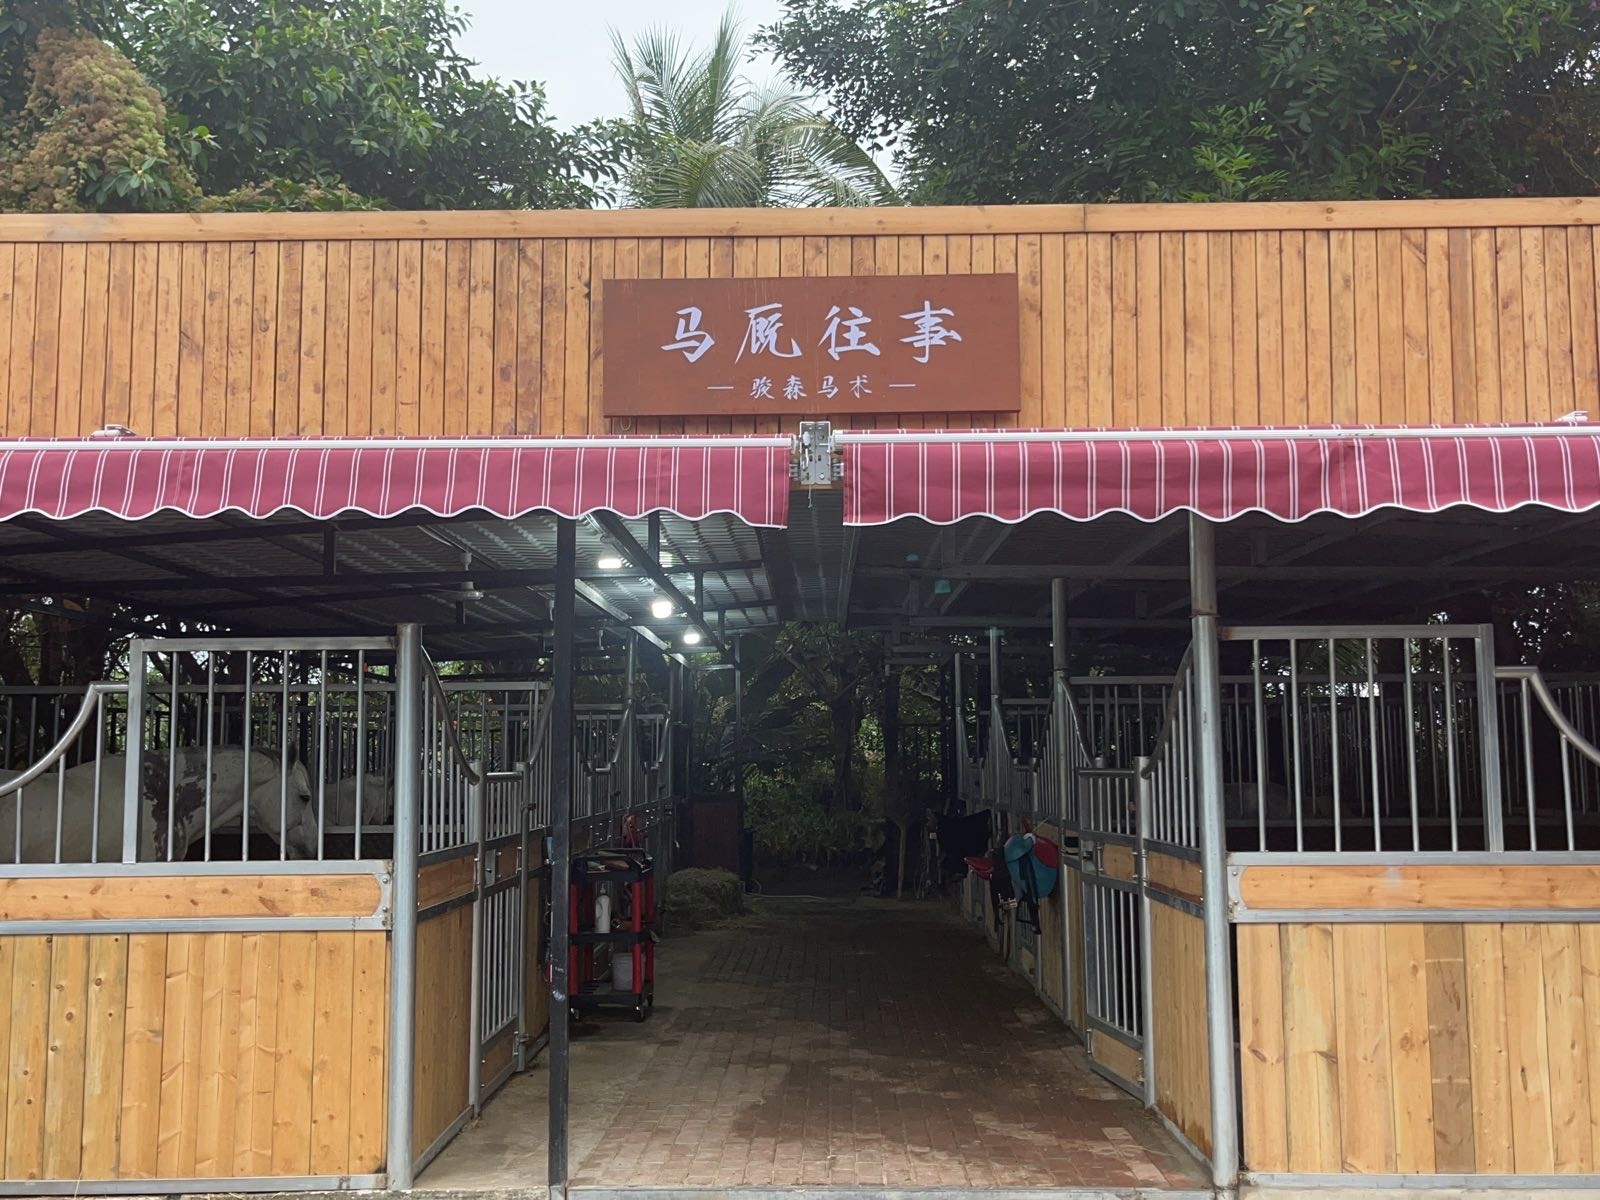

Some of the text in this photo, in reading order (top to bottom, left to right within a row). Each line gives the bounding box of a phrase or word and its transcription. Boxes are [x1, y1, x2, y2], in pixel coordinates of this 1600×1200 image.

[660, 300, 963, 364] 马厩往事
[749, 374, 873, 400] 骏森马术
